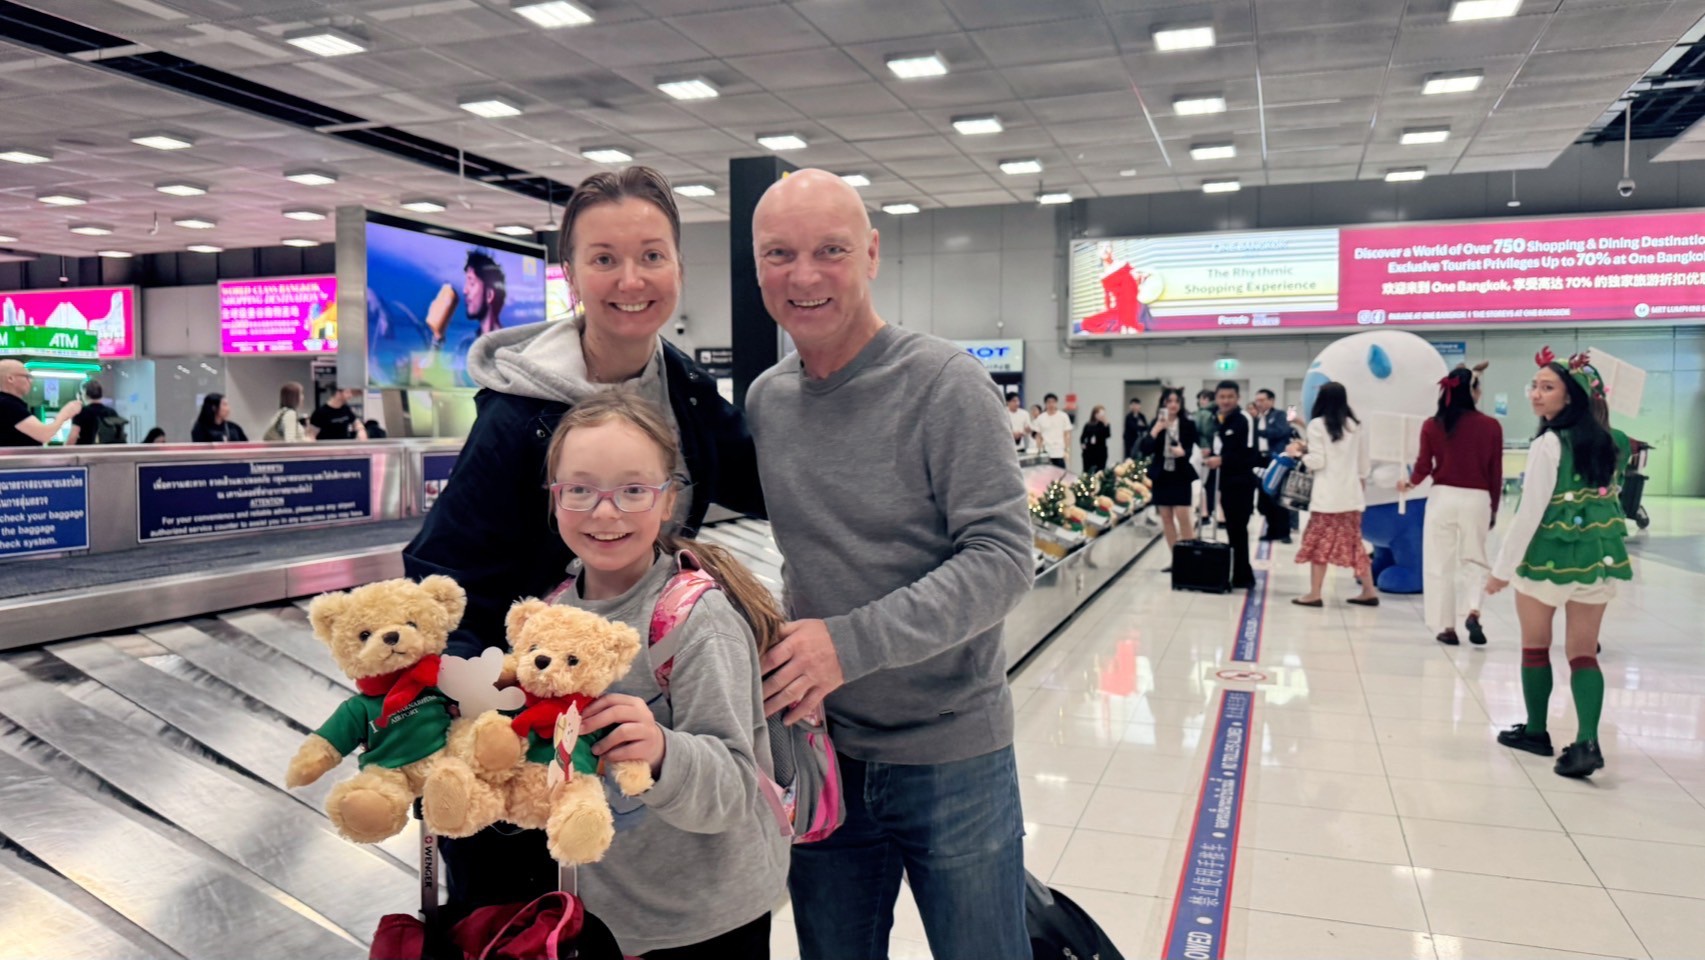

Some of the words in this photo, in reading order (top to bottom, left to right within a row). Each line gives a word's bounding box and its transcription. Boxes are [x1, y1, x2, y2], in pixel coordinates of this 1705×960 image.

[1354, 248, 1402, 259] Discover
[1403, 249, 1411, 257] a
[1412, 244, 1448, 257] World
[1449, 244, 1462, 256] of
[1463, 244, 1492, 255] Over
[1493, 238, 1526, 253] 750
[1527, 240, 1585, 253] Shopping
[1586, 239, 1596, 249] &
[1598, 237, 1640, 250] Dining
[1388, 262, 1440, 273] Exclusive
[1441, 259, 1481, 271] Tourist
[1483, 257, 1539, 270] Privileges
[1542, 256, 1559, 269] Up
[1561, 257, 1575, 266] to
[1576, 252, 1610, 266] 70%
[1613, 254, 1626, 265] at
[1628, 253, 1655, 264] One
[1208, 269, 1229, 278] The
[1232, 266, 1293, 278] Rhythmic
[1185, 284, 1243, 294] Shopping
[1246, 281, 1316, 293] Experience
[1431, 282, 1456, 293] One
[1457, 280, 1511, 294] Bangkok,
[1565, 276, 1592, 288] 70%
[49, 332, 78, 348] ATM
[27, 512, 47, 523] your
[48, 510, 84, 520] baggage
[162, 516, 174, 525] For
[176, 516, 192, 525] your
[194, 513, 235, 522] convenience
[1, 526, 16, 536] the
[18, 525, 55, 535] baggage
[189, 525, 212, 533] service
[23, 537, 57, 548] system.
[391, 708, 419, 724] AIRPORT
[369, 720, 378, 734] I
[424, 846, 432, 888] WENGER
[1188, 843, 1227, 906] 禁止使用手推车
